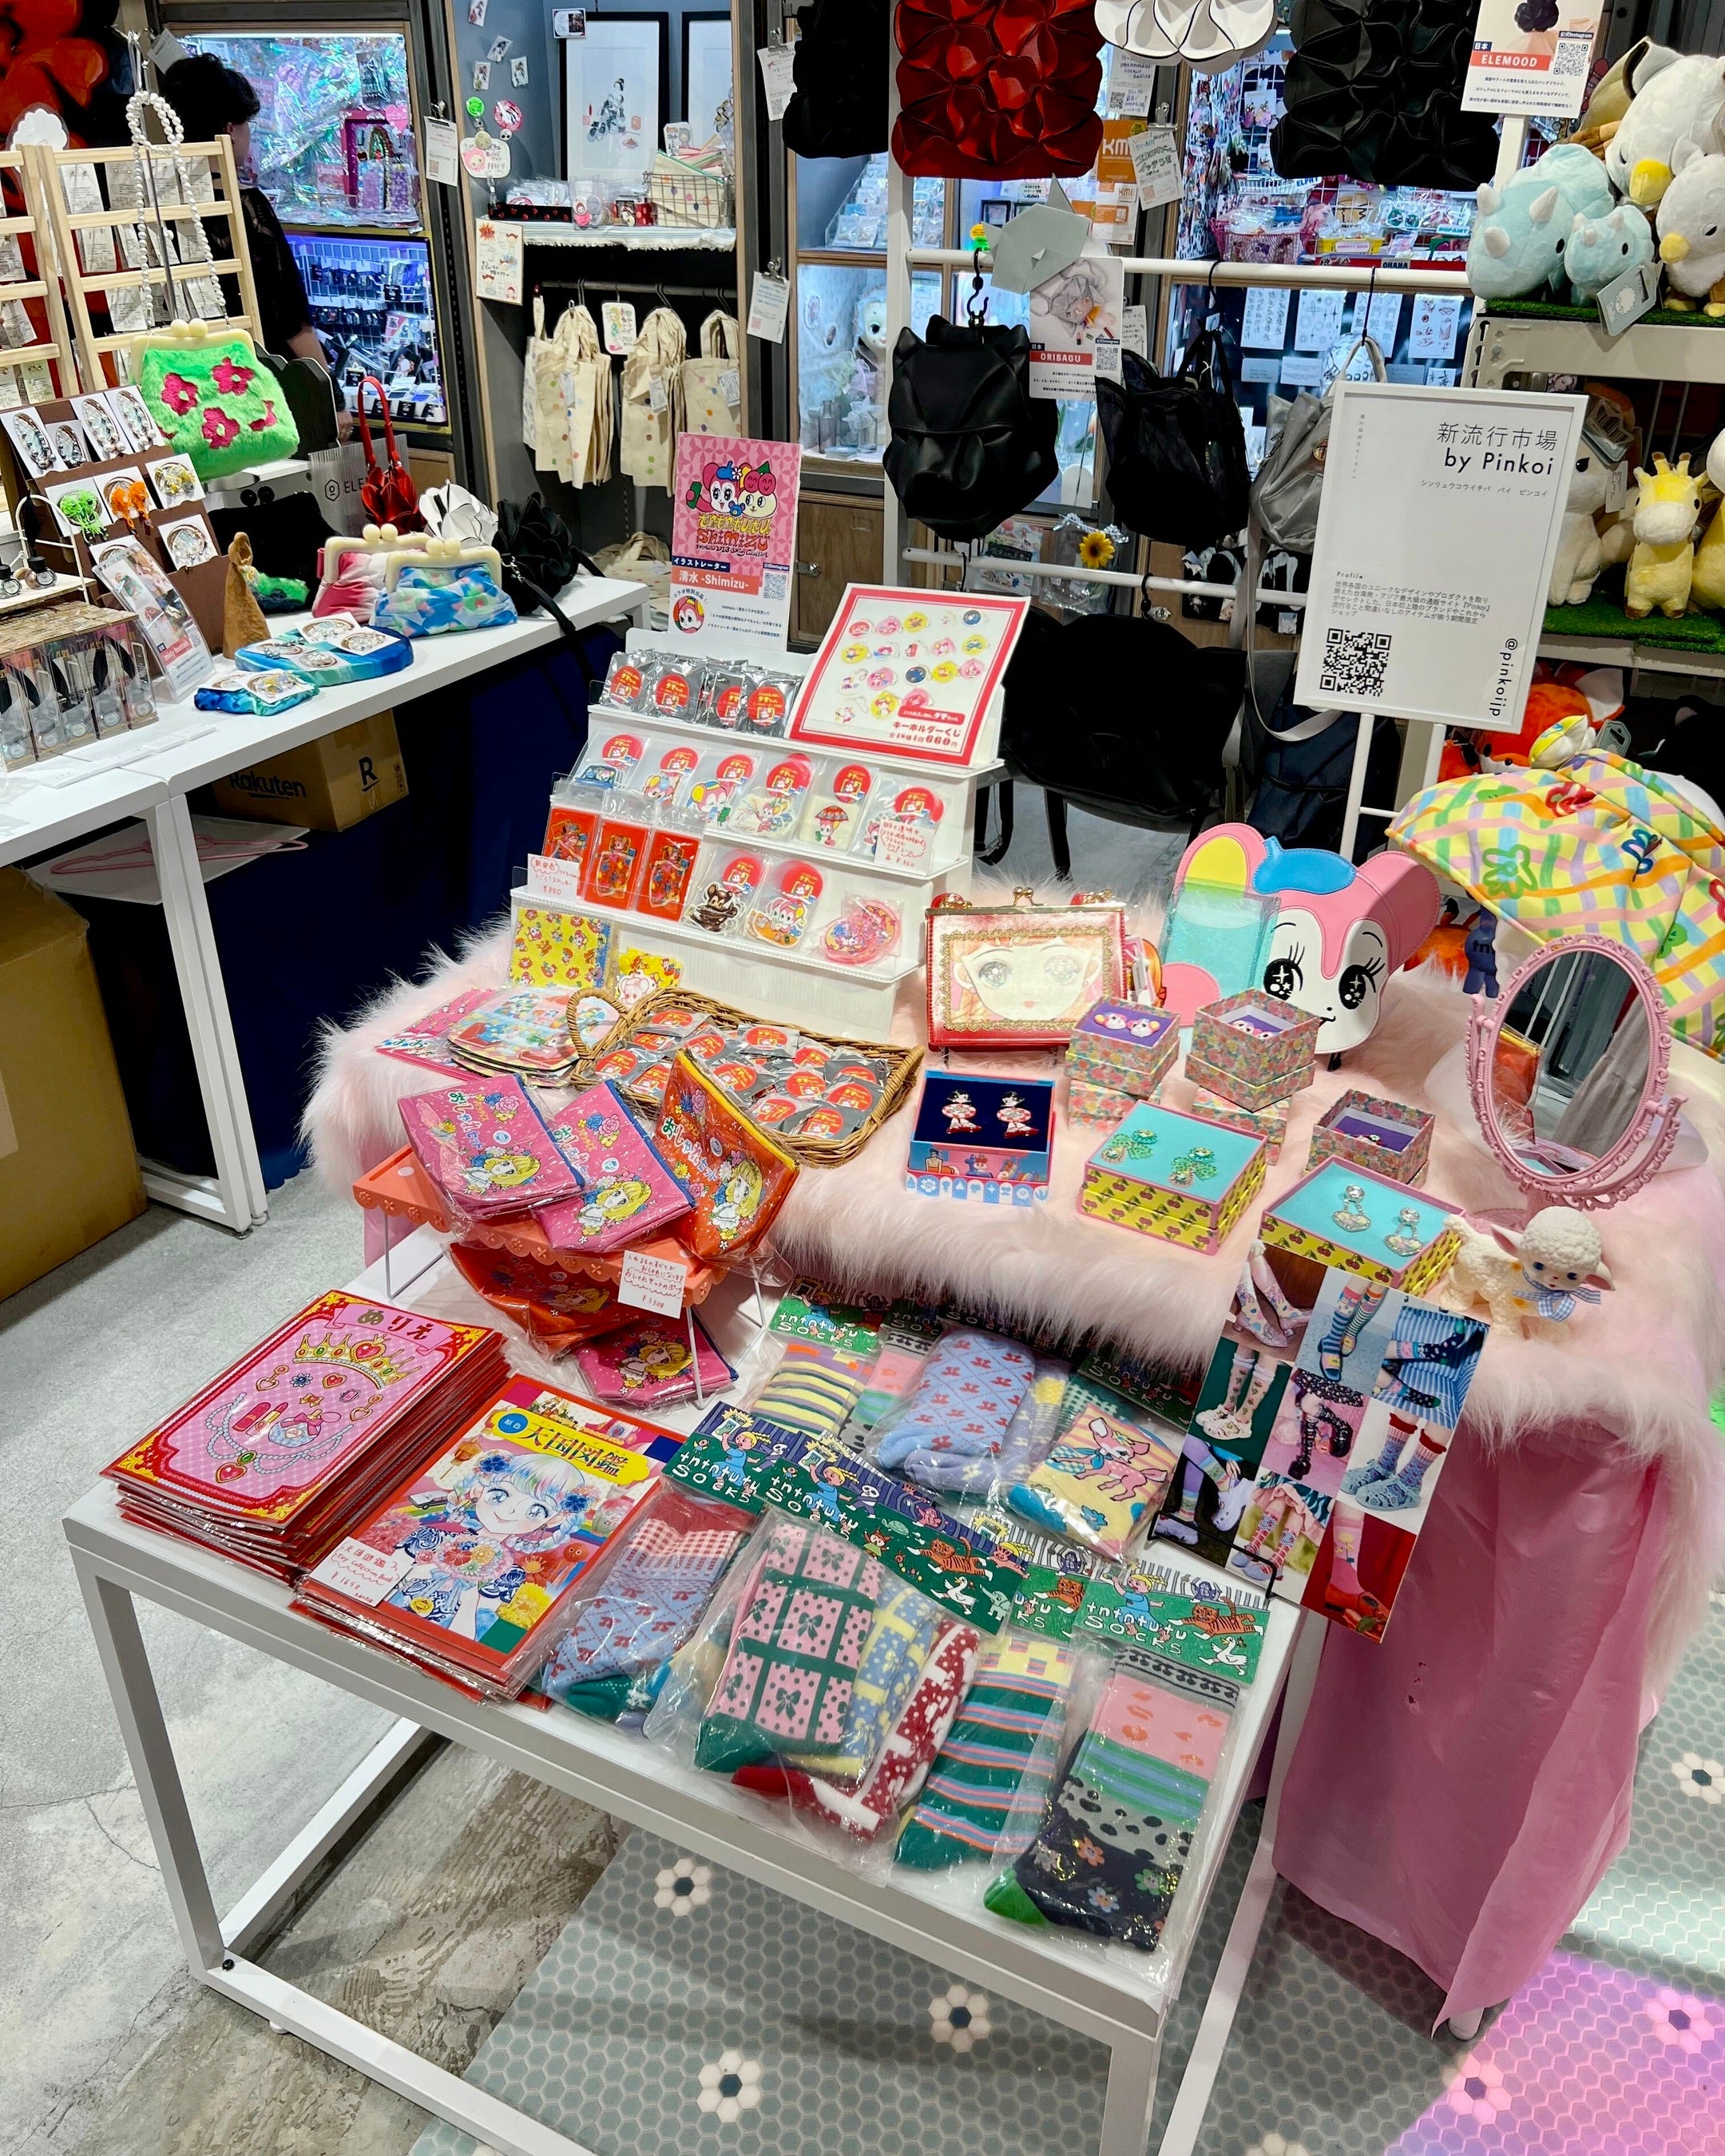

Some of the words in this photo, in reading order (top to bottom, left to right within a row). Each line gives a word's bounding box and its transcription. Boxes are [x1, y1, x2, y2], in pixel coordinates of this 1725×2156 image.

[1481, 54, 1538, 67] ELEMOOD
[1040, 353, 1081, 363] ORIBAGU
[1437, 422, 1558, 451] 新流行市場
[1444, 447, 1472, 473] by
[1482, 452, 1555, 475] Pinkoi
[674, 557, 728, 569] イラストレーター
[679, 570, 699, 584] 清水
[700, 573, 749, 590] -Shimizu-
[1489, 638, 1517, 717] @pinkoijp
[893, 722, 962, 737] キーホルダーくじ
[229, 771, 307, 798] Rakuten
[359, 756, 378, 786] R
[447, 1091, 486, 1151] おしゃれセット
[661, 1116, 720, 1183] おしゃれセット
[357, 1309, 434, 1340] ぬりえ
[779, 1313, 858, 1338] tntntutu
[779, 1322, 853, 1347] SOCKS
[1089, 1365, 1165, 1411] SOCKS
[503, 1417, 522, 1431] 原色
[516, 1424, 629, 1478] 天国図鑑
[672, 1464, 751, 1504] SOCKS
[680, 1452, 760, 1493] tntntutu
[766, 1487, 850, 1541] SOCKS
[771, 1476, 859, 1529] tntntutu
[336, 1552, 349, 1562] Toy
[351, 1560, 379, 1577] Collection
[379, 1574, 394, 1583] Book
[345, 1545, 387, 1567] 天国図鑑
[1084, 1615, 1182, 1655] SOCKS
[1087, 1601, 1188, 1640] tntntutu
